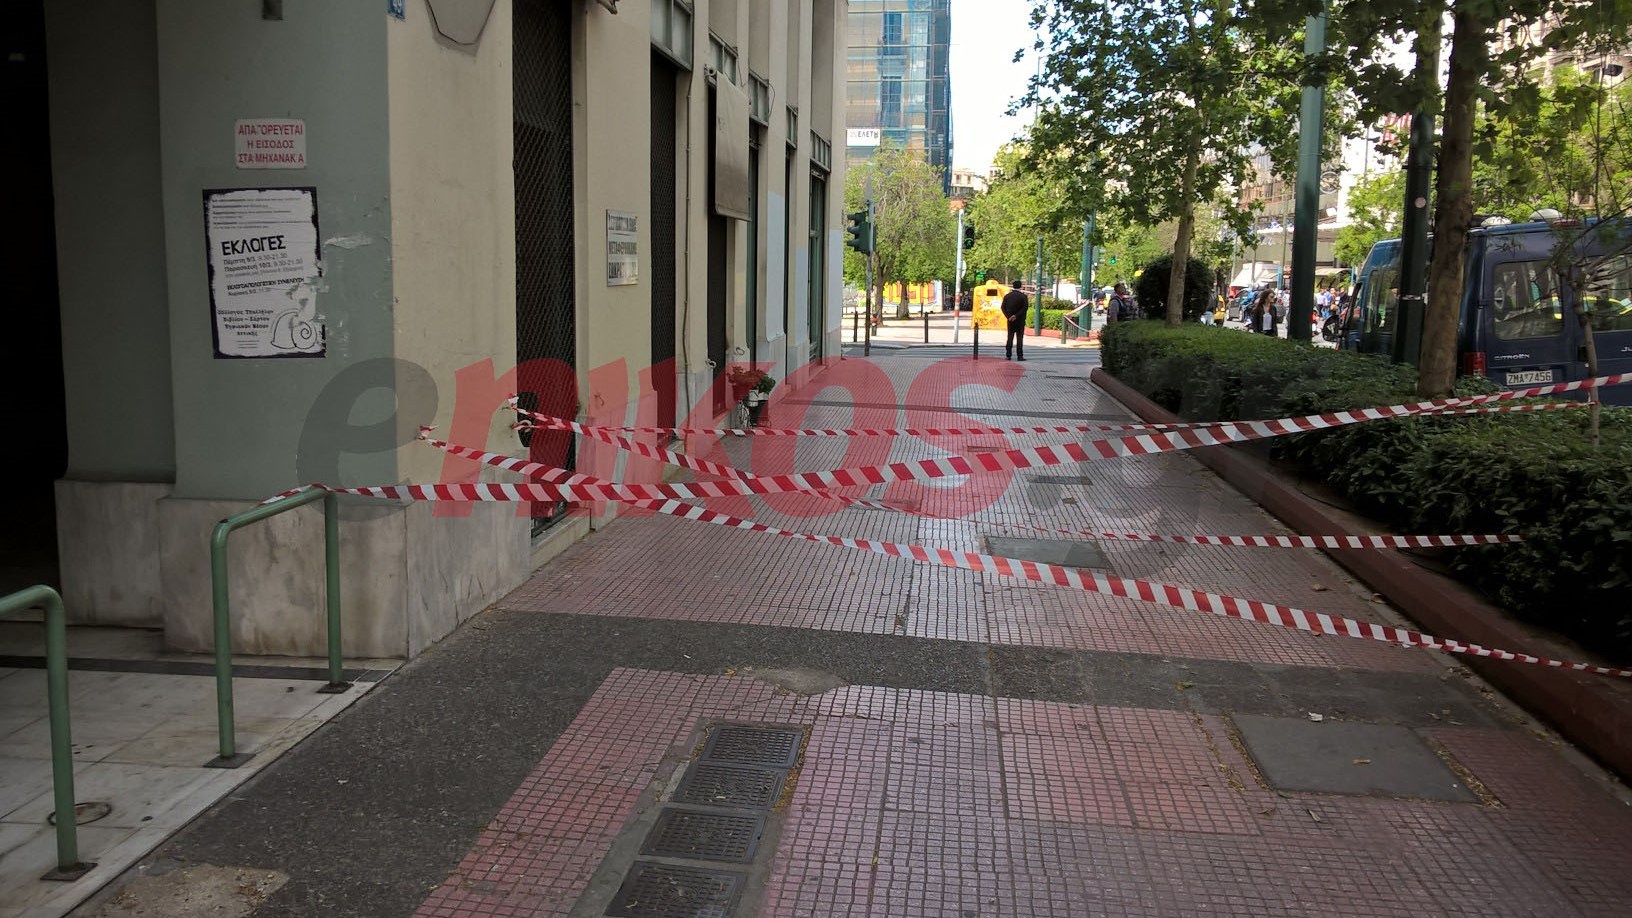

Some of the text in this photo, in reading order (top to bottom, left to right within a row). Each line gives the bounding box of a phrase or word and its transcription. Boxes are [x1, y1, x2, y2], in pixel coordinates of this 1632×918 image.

[247, 139, 295, 149] Η ΕΙΣΟΔΟΣ
[238, 153, 304, 163] ΣΤΑ ΜΗΧΑΝΑΚΑ
[221, 235, 286, 256] ΕΚΛΟΓΕΣ
